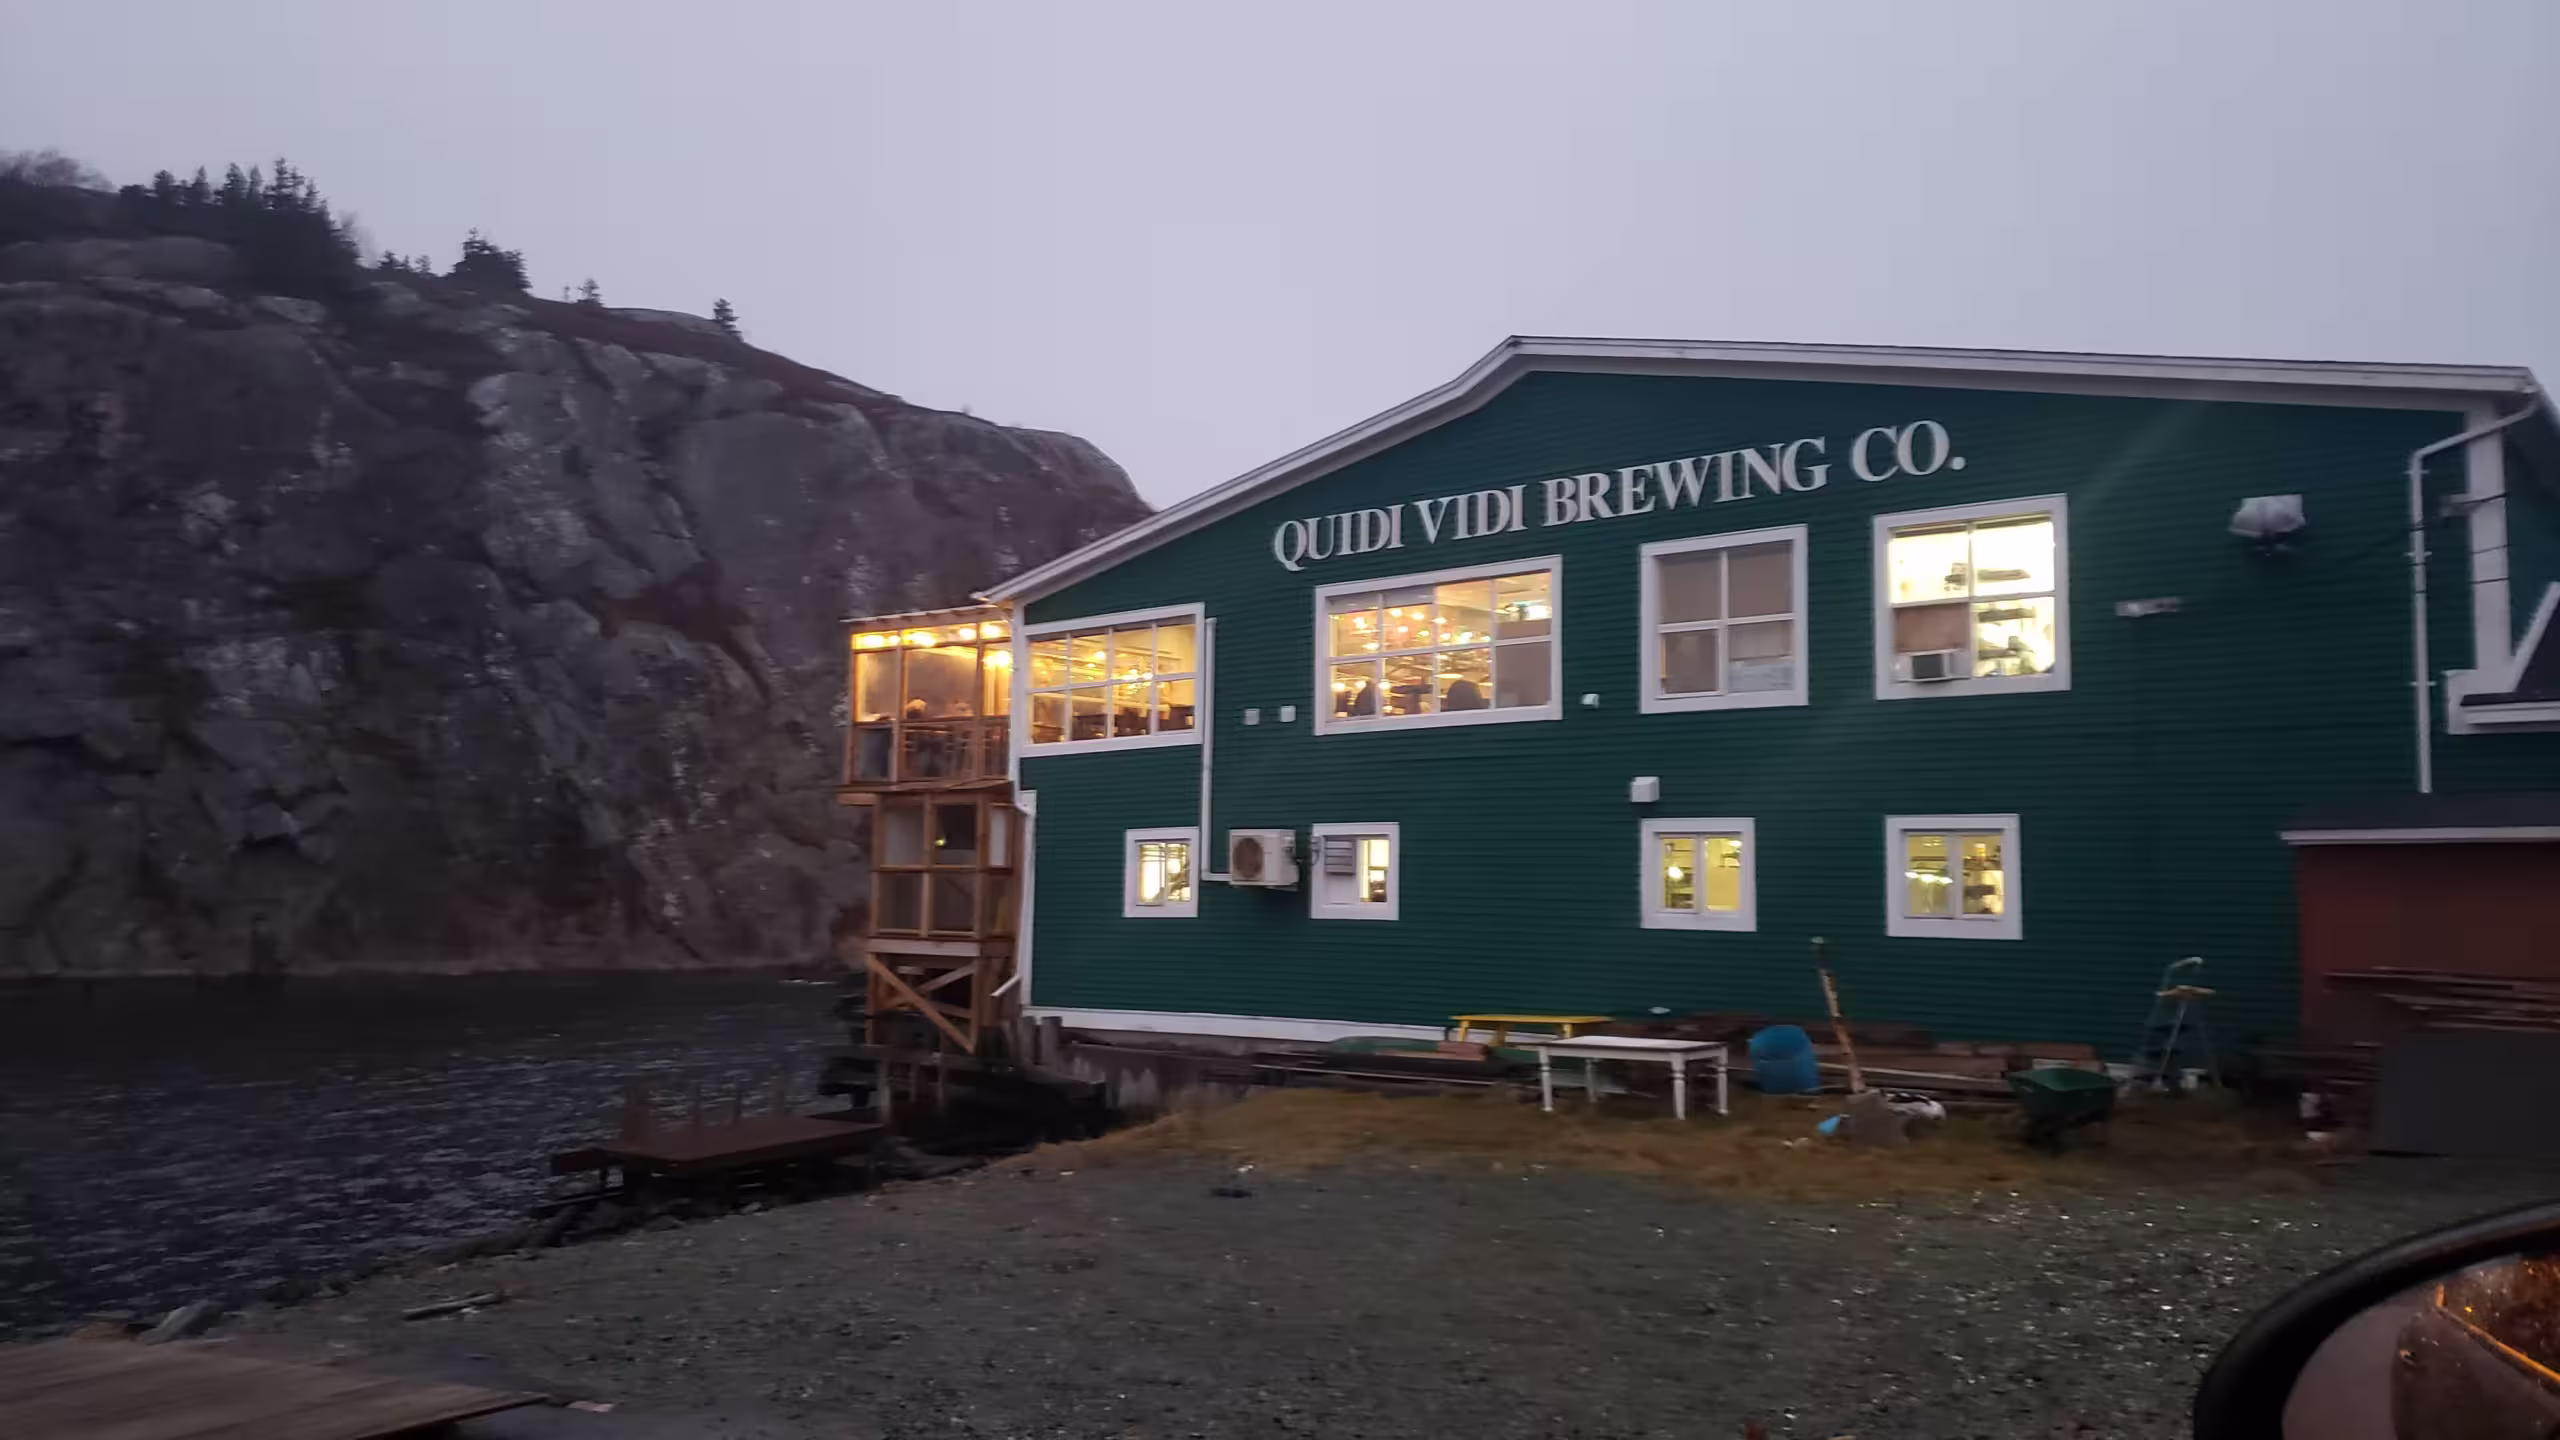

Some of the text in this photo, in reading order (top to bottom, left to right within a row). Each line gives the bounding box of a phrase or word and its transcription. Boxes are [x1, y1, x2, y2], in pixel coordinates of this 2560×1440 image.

[1273, 420, 1967, 573] QUIDI VIDI BREWING CO.
